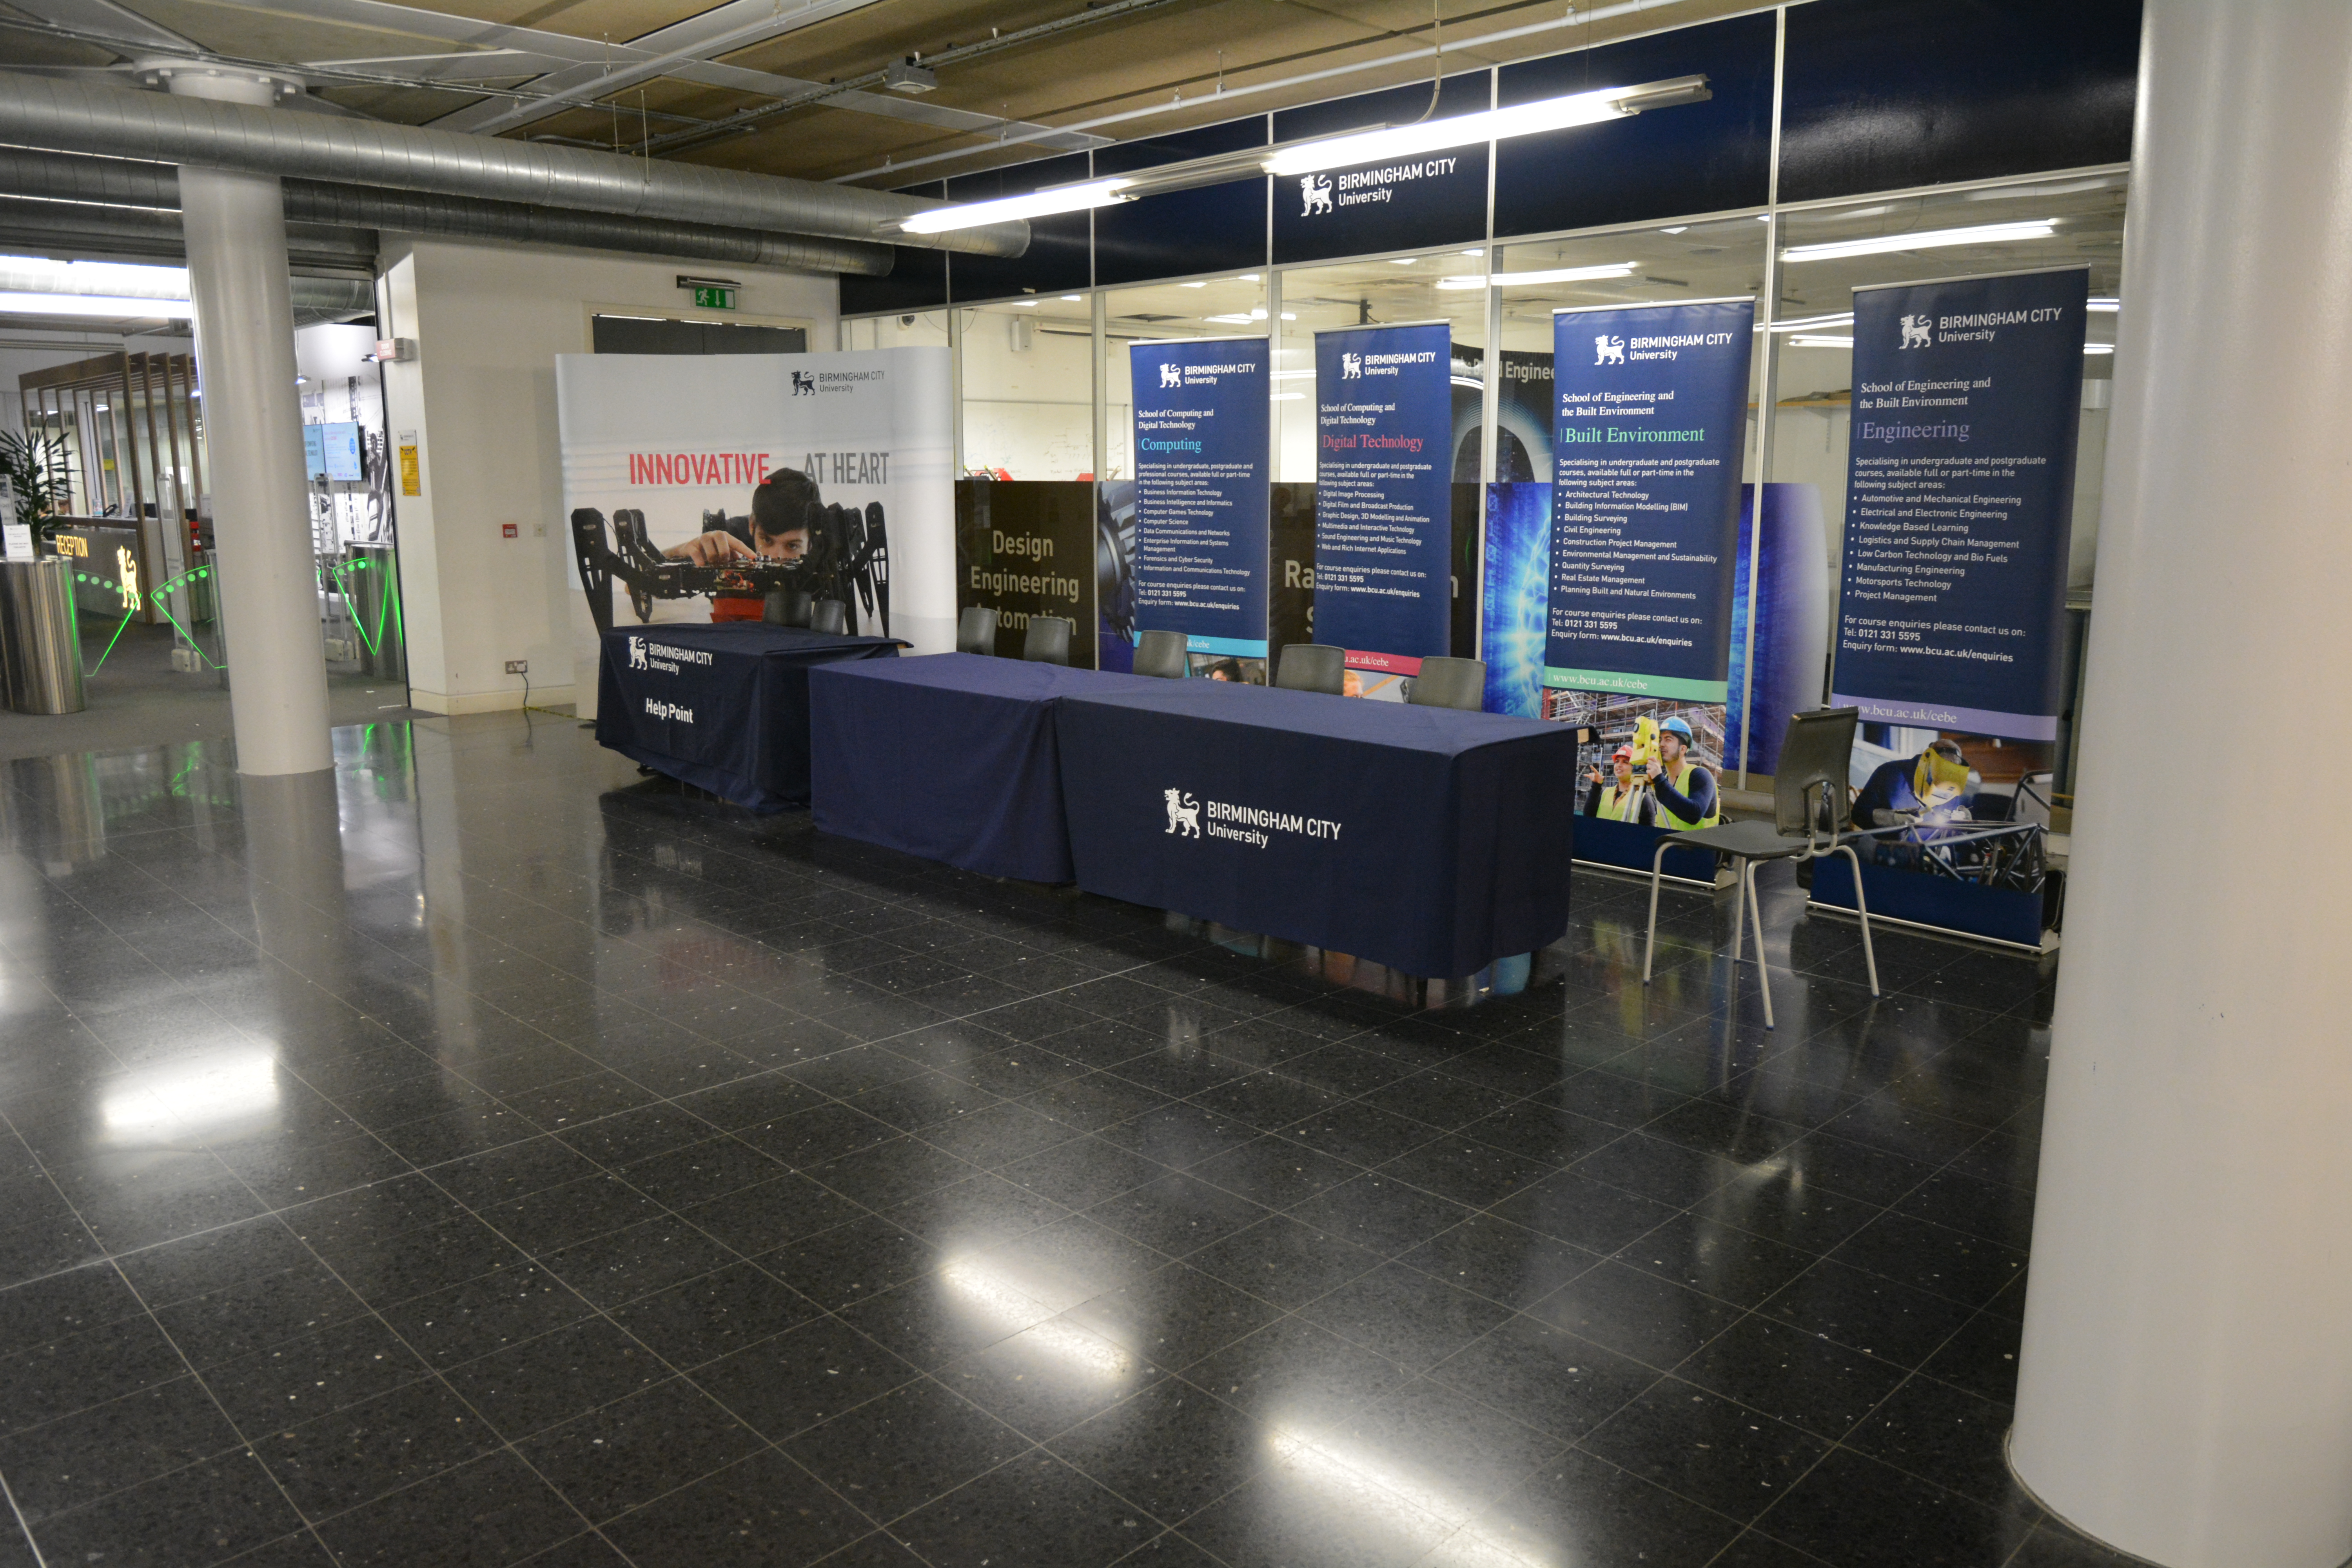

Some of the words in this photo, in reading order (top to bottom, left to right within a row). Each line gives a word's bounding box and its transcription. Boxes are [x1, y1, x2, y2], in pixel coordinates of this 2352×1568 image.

[1339, 163, 1423, 190] BIRMINGHAM
[1426, 157, 1456, 177] CITY
[1339, 188, 1392, 206] University
[1939, 310, 2027, 329] BIRMINGHAM
[2031, 307, 2062, 322] CITY
[1630, 334, 1704, 349] BIRMINGHAM
[1706, 332, 1733, 345] CITY
[1938, 329, 1995, 343] University
[1365, 353, 1417, 365] BIRMINGHAM
[1417, 352, 1436, 363] CITY
[1630, 349, 1678, 361] University
[819, 372, 869, 382] BIRMINGHAM
[871, 370, 884, 380] CITY
[1185, 364, 1236, 375] BIRMINGHAM
[1237, 363, 1256, 373] CITY
[1365, 366, 1399, 376] University
[1185, 376, 1218, 385] University
[1860, 381, 1893, 393] School
[1895, 380, 1907, 392] of
[1907, 378, 1970, 393] Engineering
[1973, 377, 1991, 388] and
[819, 384, 853, 394] University
[1562, 392, 1590, 403] School
[1592, 392, 1603, 402] of
[1604, 391, 1656, 404] Engineering
[1658, 390, 1674, 400] and
[1860, 399, 1873, 409] the
[1875, 397, 1900, 408] Built
[1901, 396, 1968, 407] Environment
[1138, 410, 1158, 418] School
[1159, 409, 1167, 417] of
[1167, 409, 1202, 419] Computing
[1321, 403, 1339, 412] School
[1340, 403, 1347, 412] of
[1347, 403, 1383, 414] Computing
[1384, 402, 1396, 411] and
[1562, 407, 1574, 417] the
[1576, 407, 1597, 416] Built
[1599, 406, 1654, 416] Environment
[1138, 421, 1158, 431] Digital
[1159, 421, 1196, 430] Technology
[1321, 416, 1339, 426] Digital
[1339, 415, 1376, 426] Technology
[1565, 427, 1602, 443] Built
[1606, 426, 1704, 442] Environment
[1862, 421, 1970, 443] Engineering
[1141, 437, 1201, 454] Computing
[1323, 434, 1357, 451] Digital
[1359, 434, 1423, 452] Technology
[629, 453, 771, 485] INNOVATIVE
[804, 453, 827, 484] AT
[833, 452, 889, 484] HEART
[1559, 458, 1599, 468] Specialising
[1608, 458, 1659, 468] undergraduate
[1674, 458, 1720, 467] postgraduate
[1641, 469, 1674, 477] part-time
[1559, 478, 1588, 488] following
[1589, 479, 1614, 488] subject
[1196, 489, 1222, 497] Technology
[1323, 490, 1338, 498] Digital
[1338, 491, 1354, 499] Image
[1354, 490, 1385, 500] Processing
[1611, 491, 1649, 501] Technology
[1187, 508, 1214, 517] Technology
[1565, 501, 1593, 511] Building
[1636, 503, 1669, 512] Modelling
[1670, 503, 1688, 511] (BIM)
[1564, 513, 1592, 523] Building
[1593, 514, 1628, 524] Surveying
[1388, 524, 1415, 535] Technology
[1579, 526, 1621, 536] Engineering
[56, 534, 89, 557] RECEPTION
[993, 530, 1053, 562] Design
[1563, 537, 1607, 546] Construction
[1608, 539, 1632, 548] Project
[1633, 539, 1677, 550] Management
[1563, 549, 1612, 558] Environmental
[1613, 551, 1657, 561] Management
[1671, 553, 1717, 564] Sustainability
[1562, 561, 1590, 571] Quantity
[1591, 562, 1625, 573] Surveying
[1857, 563, 1913, 575] Manufacturing
[1915, 565, 1965, 577] Engineering
[971, 566, 1079, 602] Engineering
[1577, 574, 1600, 582] Estate
[1601, 575, 1645, 585] Management
[1855, 576, 1902, 587] Motorsports
[1904, 578, 1952, 590] Technology
[1561, 585, 1591, 595] Planning
[1592, 586, 1609, 595] Built
[1624, 588, 1650, 597] Natural
[1651, 589, 1696, 599] Environments
[1855, 590, 1881, 600] Project
[1882, 591, 1937, 603] Management
[1844, 615, 1857, 624] For
[1858, 618, 1887, 626] course
[1888, 619, 1931, 630] enquiries
[1933, 621, 1963, 632] please
[1964, 625, 1996, 634] contact
[1844, 627, 1857, 636] Tel:
[1858, 628, 1878, 638] 0121
[1880, 630, 1895, 639] 331
[1898, 631, 1920, 641] 5595
[649, 642, 695, 663] BIRMINGHAM
[696, 651, 713, 666] CITY
[1842, 639, 1873, 652] Enquiry
[1874, 642, 1898, 652] form:
[1900, 646, 2013, 662] www.bcu.ac.uk/enquiries
[650, 657, 679, 675] University
[1553, 674, 1648, 690] www.bcu.ac.uk/cebe
[646, 697, 668, 719] Help
[668, 703, 693, 724] Point
[1207, 800, 1303, 834] BIRMINGHAM
[1307, 818, 1341, 840] CITY
[1207, 821, 1269, 849] University
